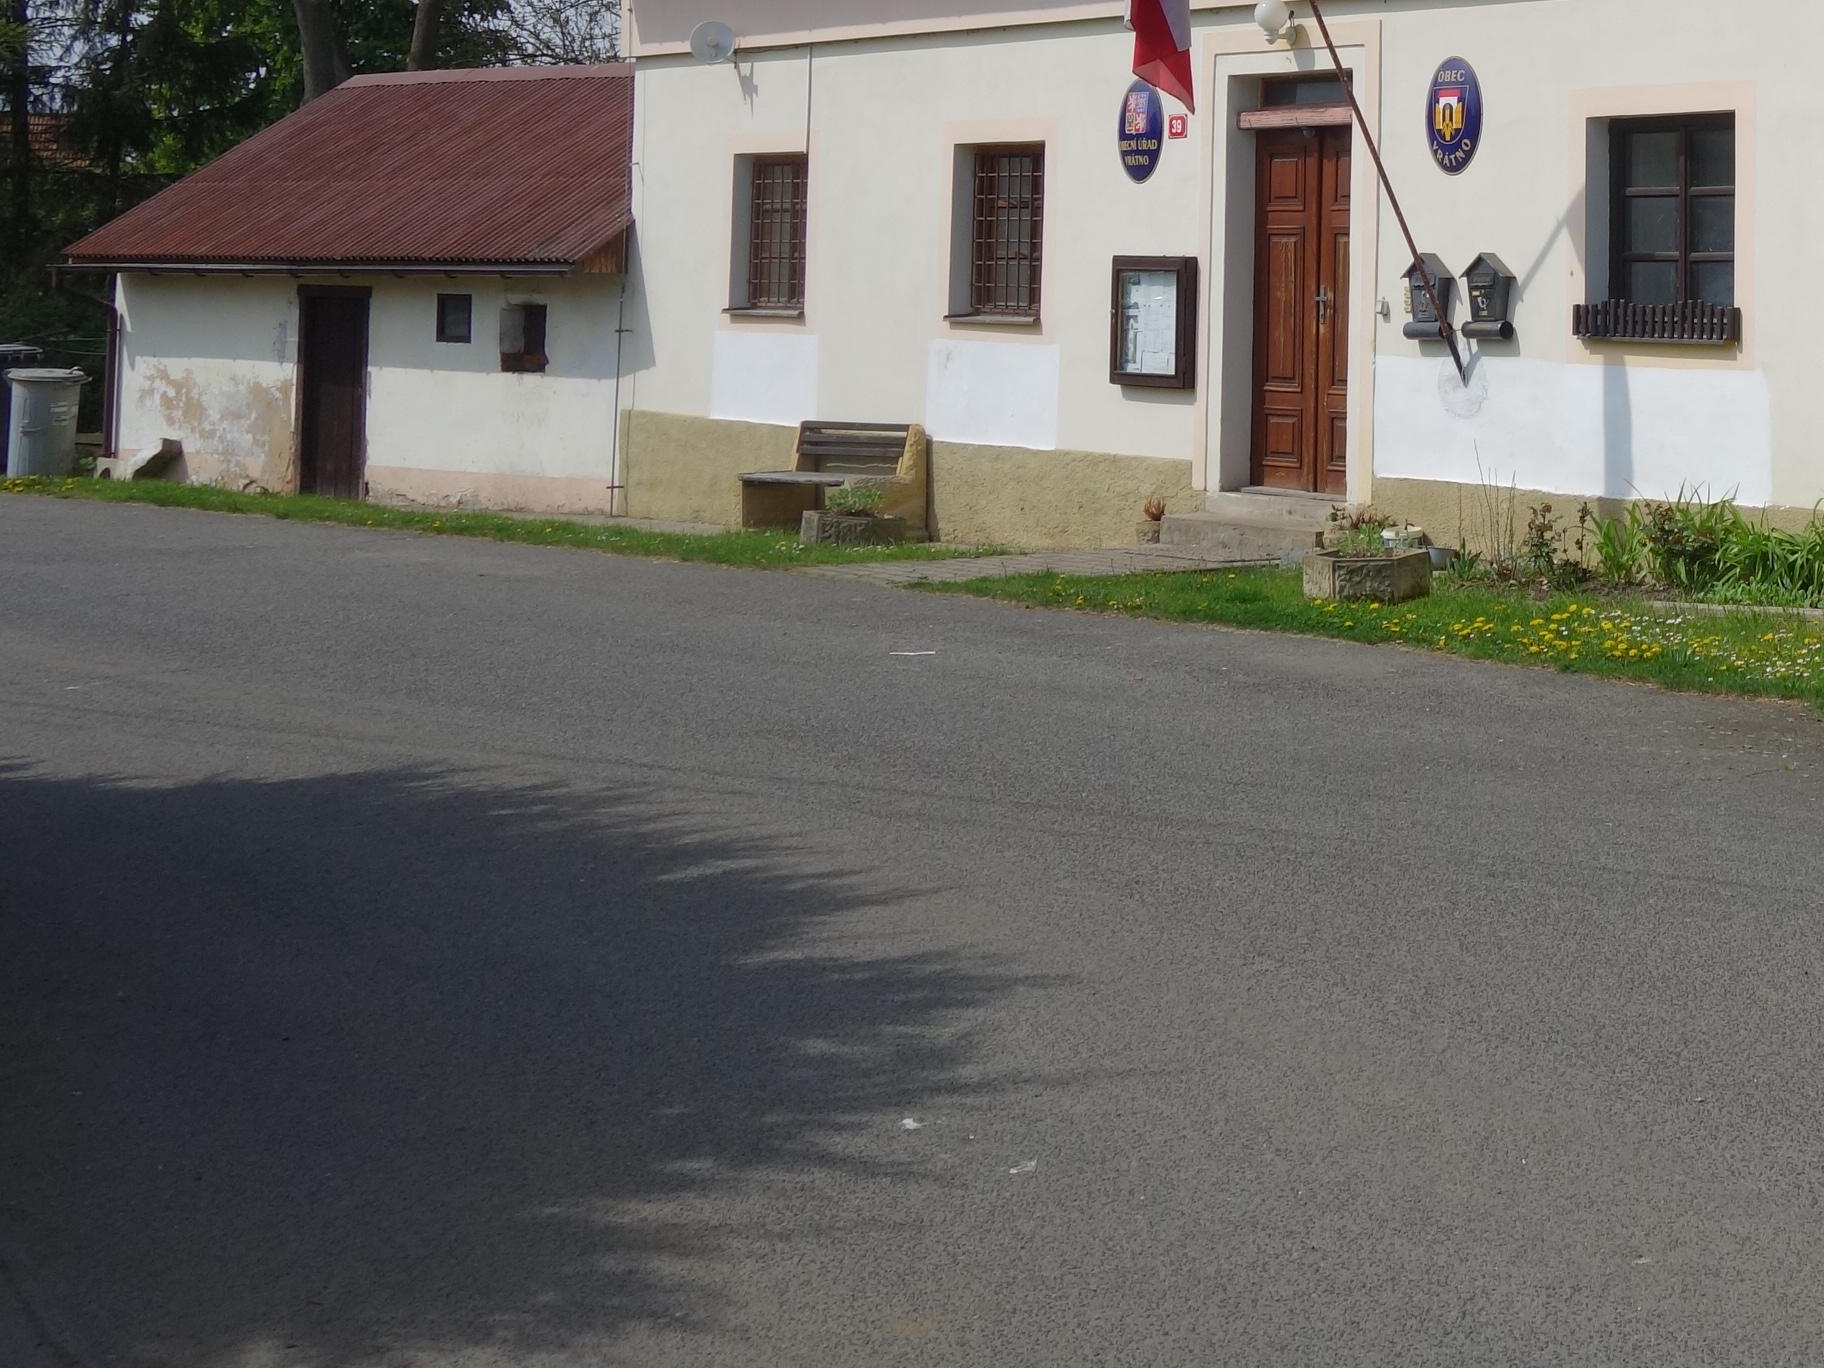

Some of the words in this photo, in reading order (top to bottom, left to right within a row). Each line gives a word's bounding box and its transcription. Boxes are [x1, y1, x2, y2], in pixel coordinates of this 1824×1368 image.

[1438, 70, 1465, 82] OBEC
[1172, 119, 1181, 132] 39
[1433, 138, 1471, 167] VRÁTNO
[1125, 153, 1149, 165] VRÁTNO
